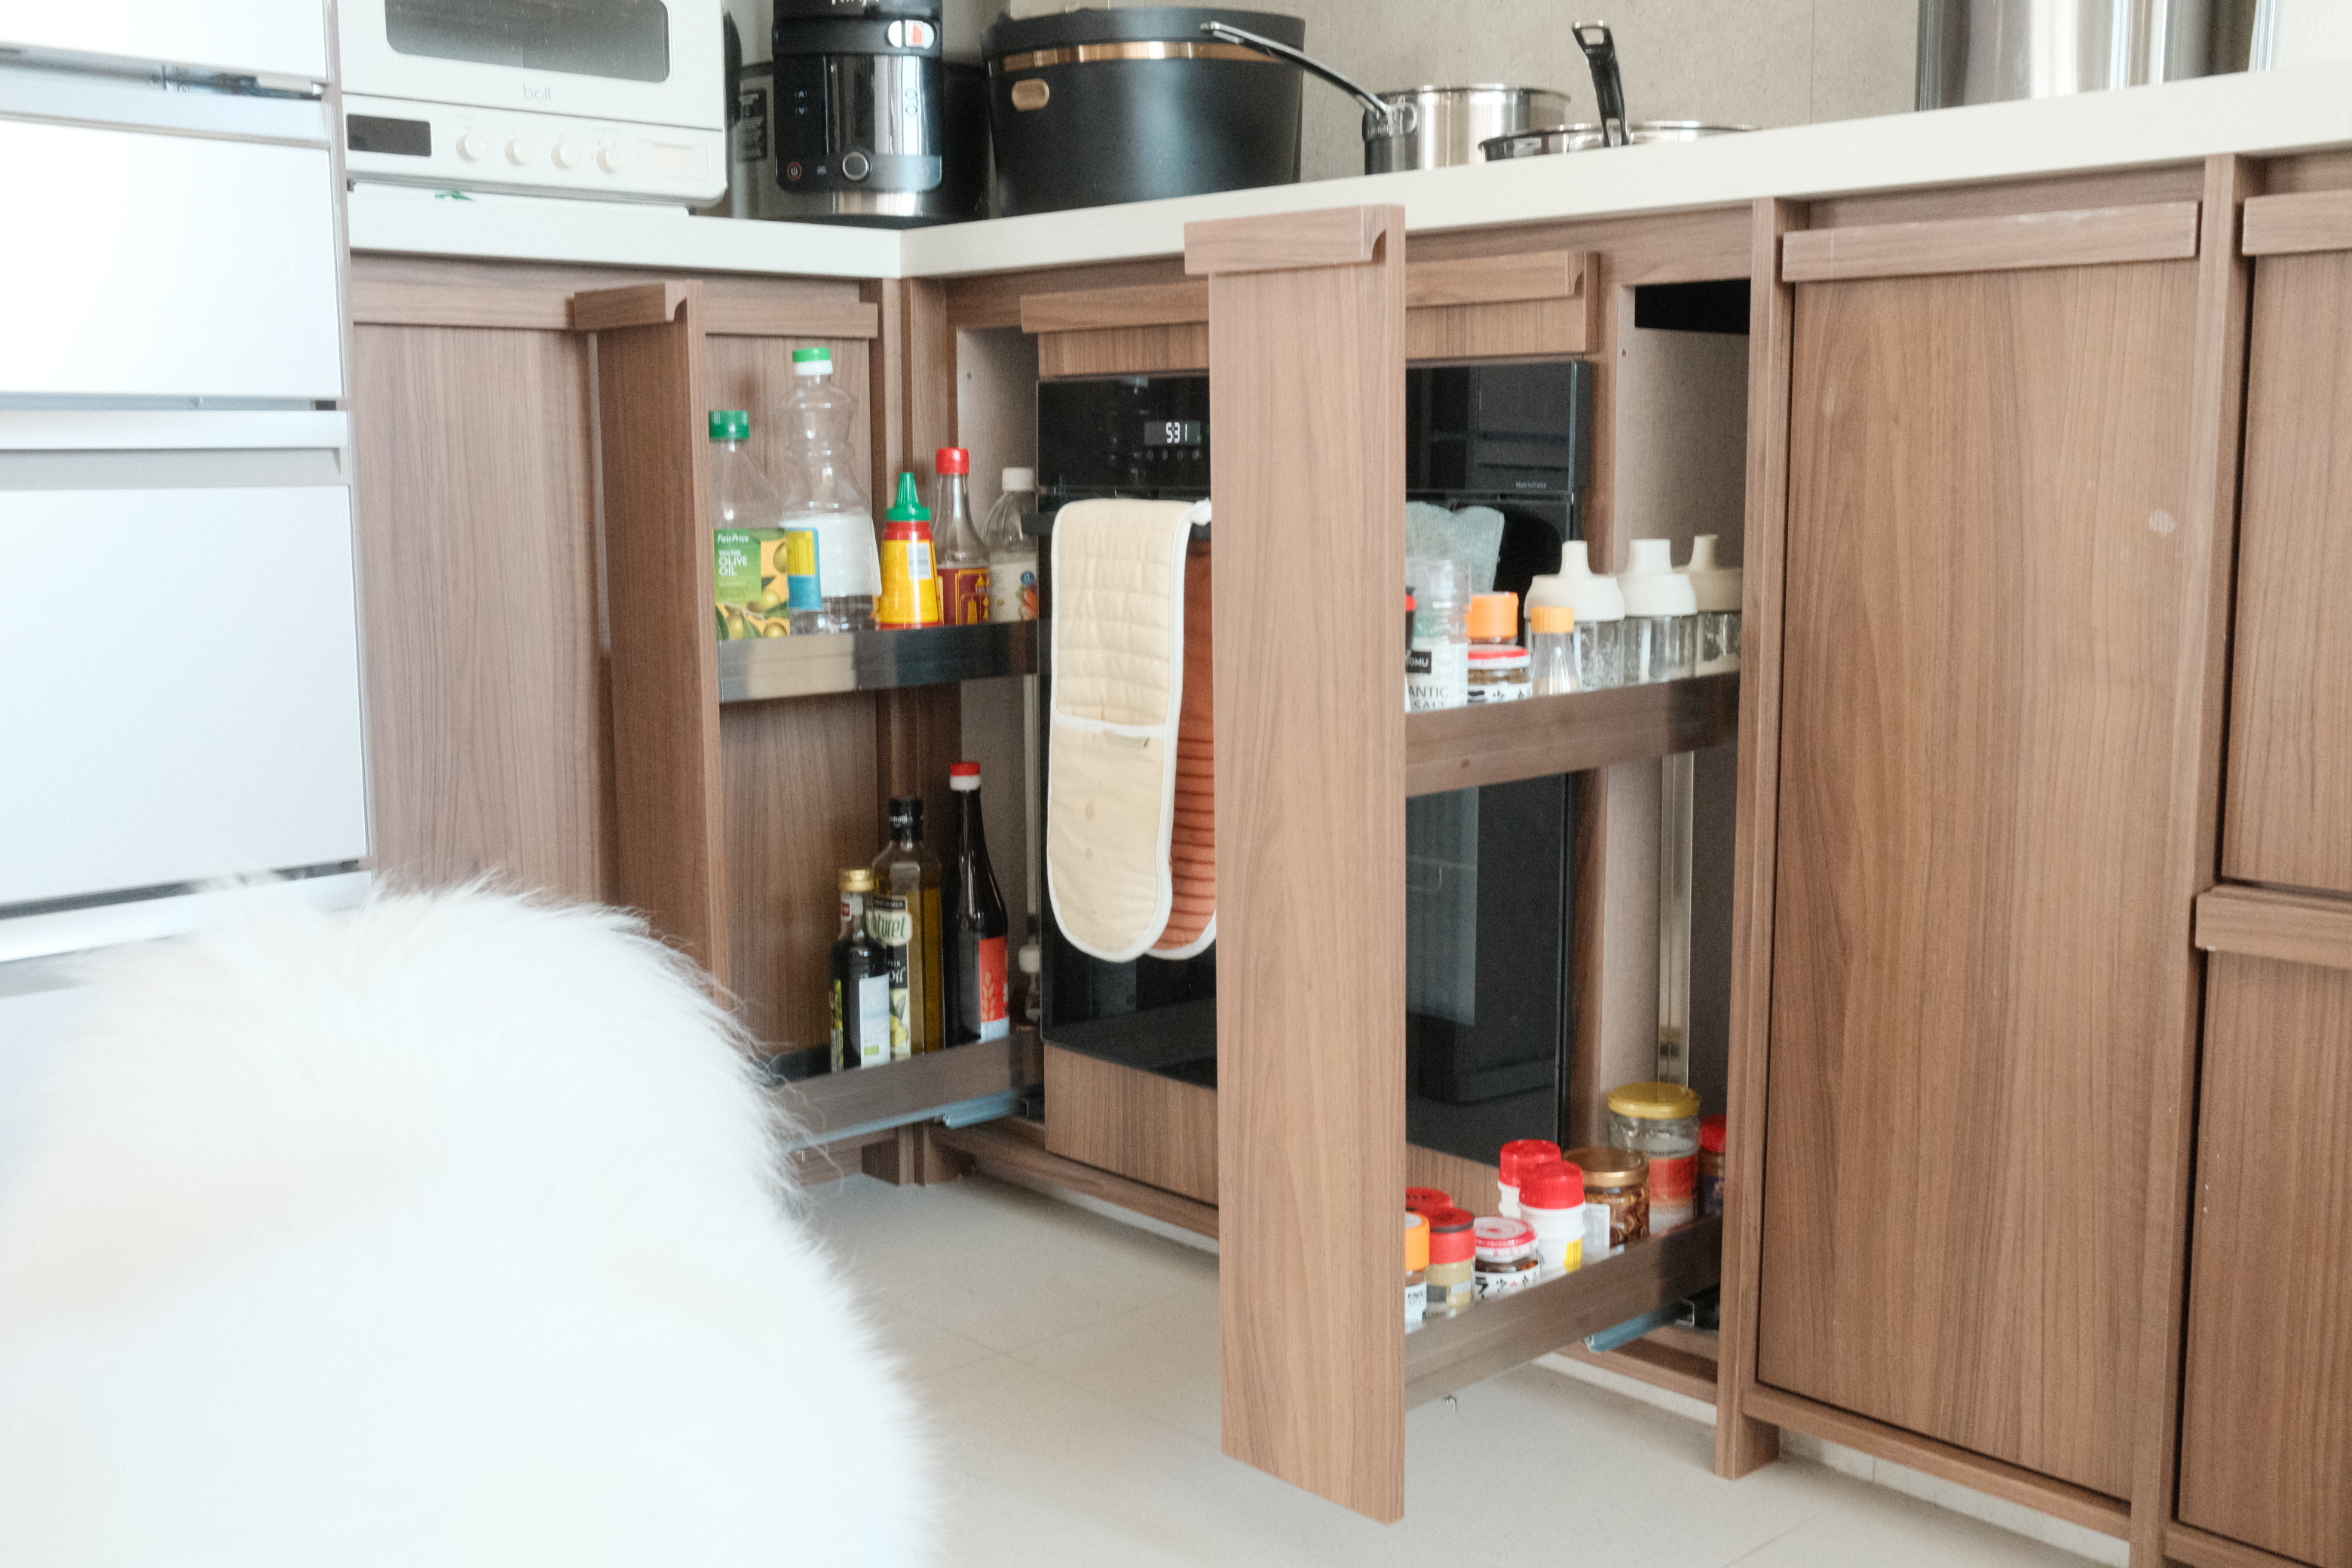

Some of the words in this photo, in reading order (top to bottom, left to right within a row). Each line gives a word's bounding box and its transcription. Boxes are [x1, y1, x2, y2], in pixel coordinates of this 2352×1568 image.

[718, 533, 749, 543] FairPrice
[719, 556, 747, 566] OLIVE
[718, 565, 737, 577] OIL
